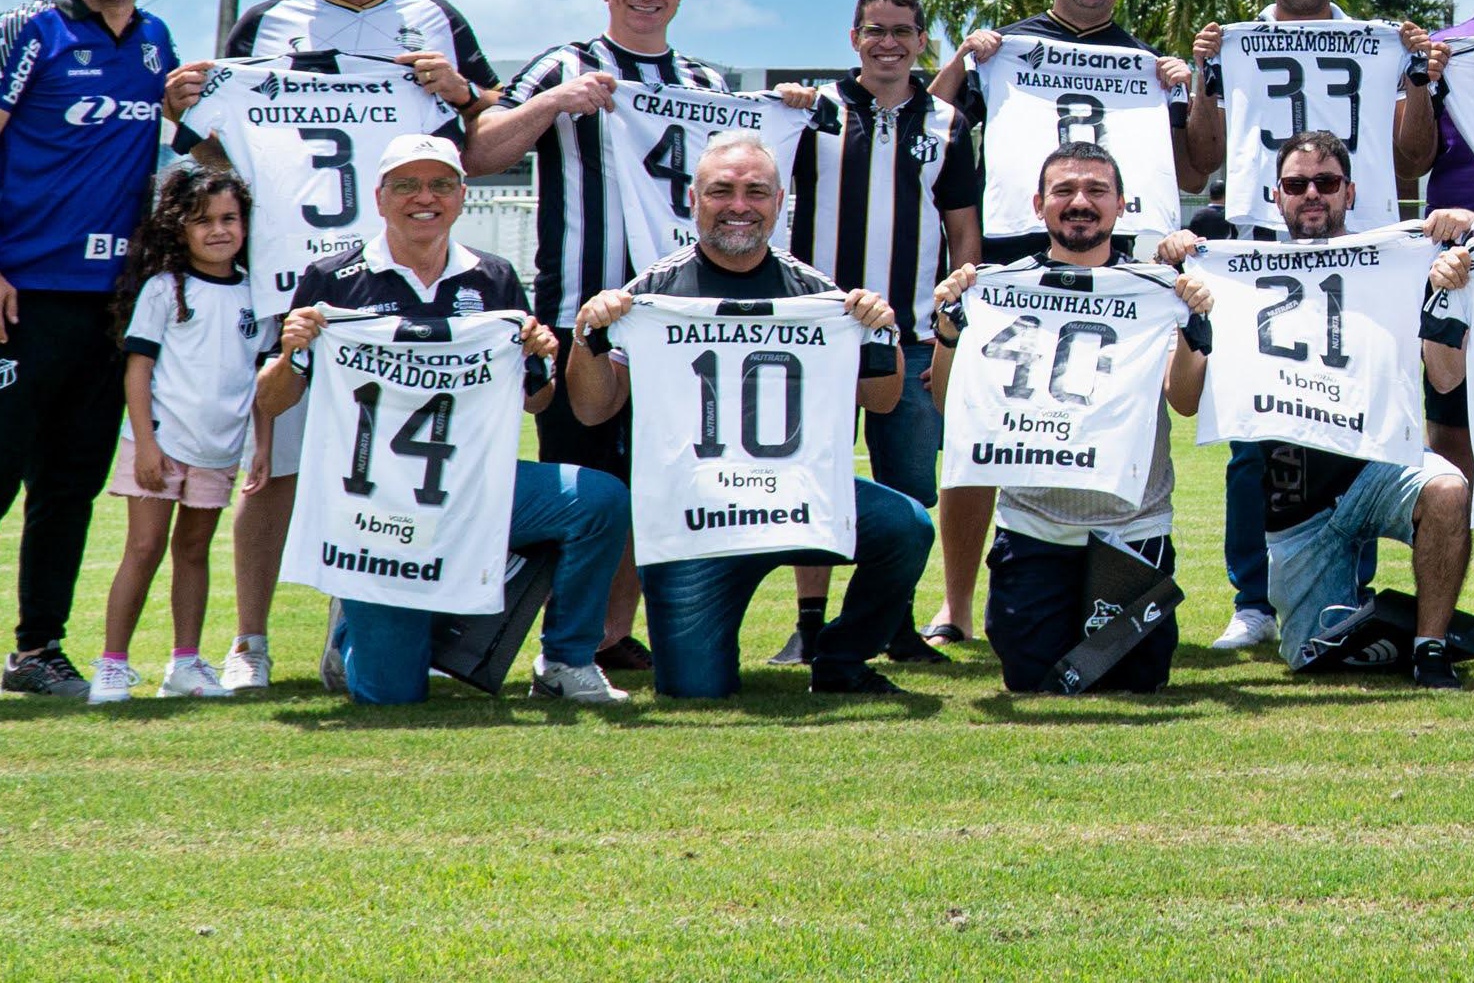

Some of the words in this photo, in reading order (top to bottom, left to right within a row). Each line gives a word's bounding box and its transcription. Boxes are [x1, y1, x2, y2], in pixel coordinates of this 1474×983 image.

[1048, 46, 1142, 70] brisanet
[1241, 35, 1379, 55] QUIXERAMOBIM/CE
[3, 38, 42, 105] betcris
[284, 77, 393, 94] brisanet
[1017, 72, 1147, 95] MARANGUAPE/CE
[248, 103, 397, 125] QUIXADÁ/CE
[633, 94, 762, 130] CRATEÚS/CE
[1255, 57, 1362, 154] 33
[298, 127, 359, 228] 3
[667, 324, 826, 346] DALLAS/USA
[1255, 274, 1351, 369] 21
[336, 346, 492, 389] SALVADOR/BA
[981, 315, 1118, 406] 40
[1295, 374, 1340, 402] bmg
[691, 350, 803, 459] 10
[1254, 395, 1365, 433] Unimed
[1019, 414, 1071, 440] bmg
[343, 382, 456, 505] 14
[972, 442, 1096, 468] Unimed
[732, 473, 777, 493] bmg
[370, 514, 414, 544] bmg
[685, 503, 810, 531] Unimed
[322, 542, 443, 581] Unimed
